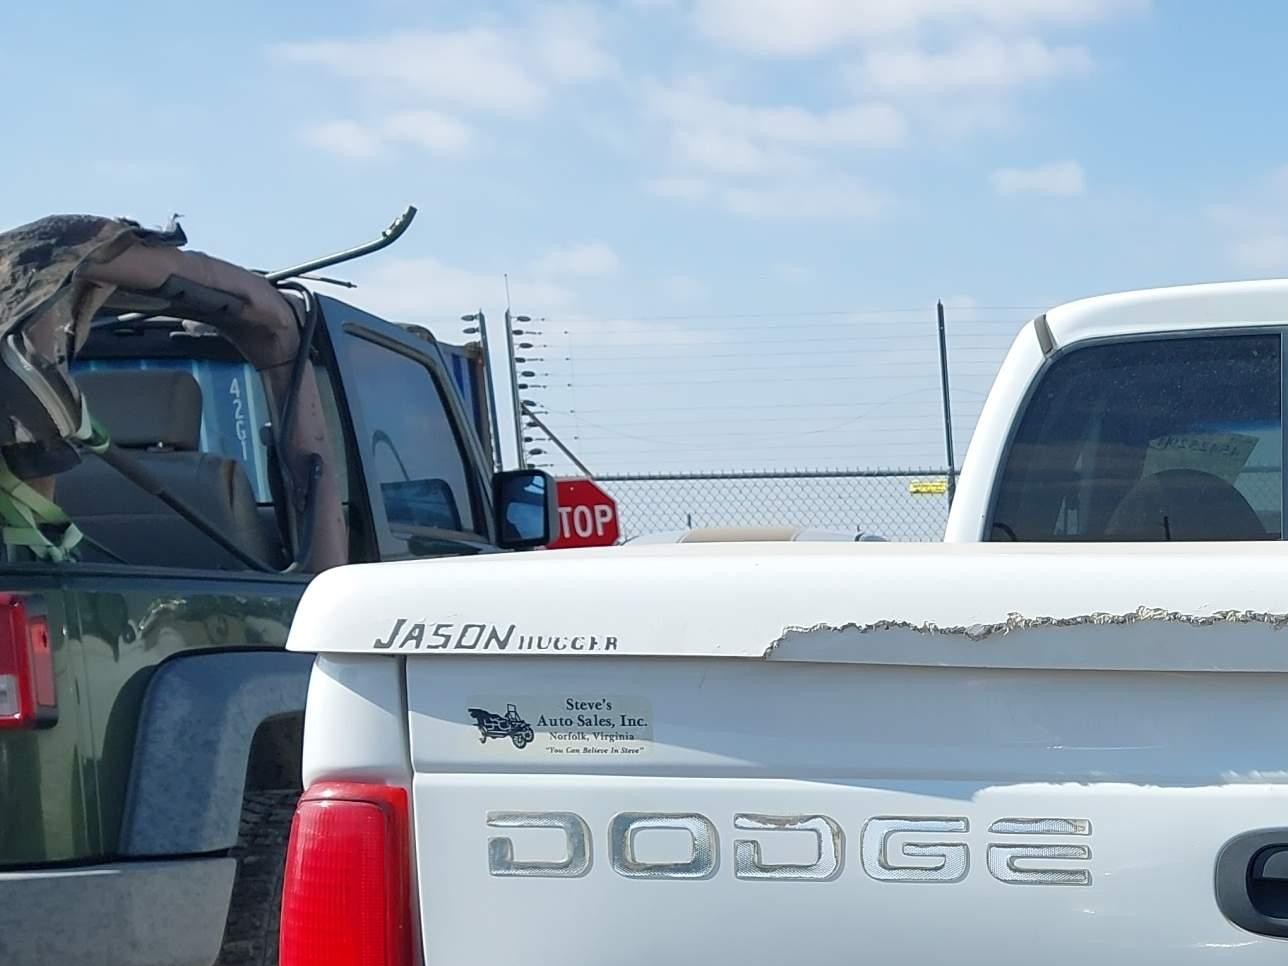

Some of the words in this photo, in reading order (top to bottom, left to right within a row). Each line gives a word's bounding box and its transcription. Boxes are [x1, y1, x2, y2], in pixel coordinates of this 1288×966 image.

[558, 504, 613, 538] TOP
[373, 618, 516, 650] JASON
[565, 697, 613, 711] Steve's
[536, 714, 574, 727] Auto
[577, 714, 616, 728] Sales,
[619, 714, 648, 727] Inc.
[549, 731, 590, 742] Norfolk,
[592, 731, 635, 743] Virginia
[486, 810, 1093, 886] DODGE
